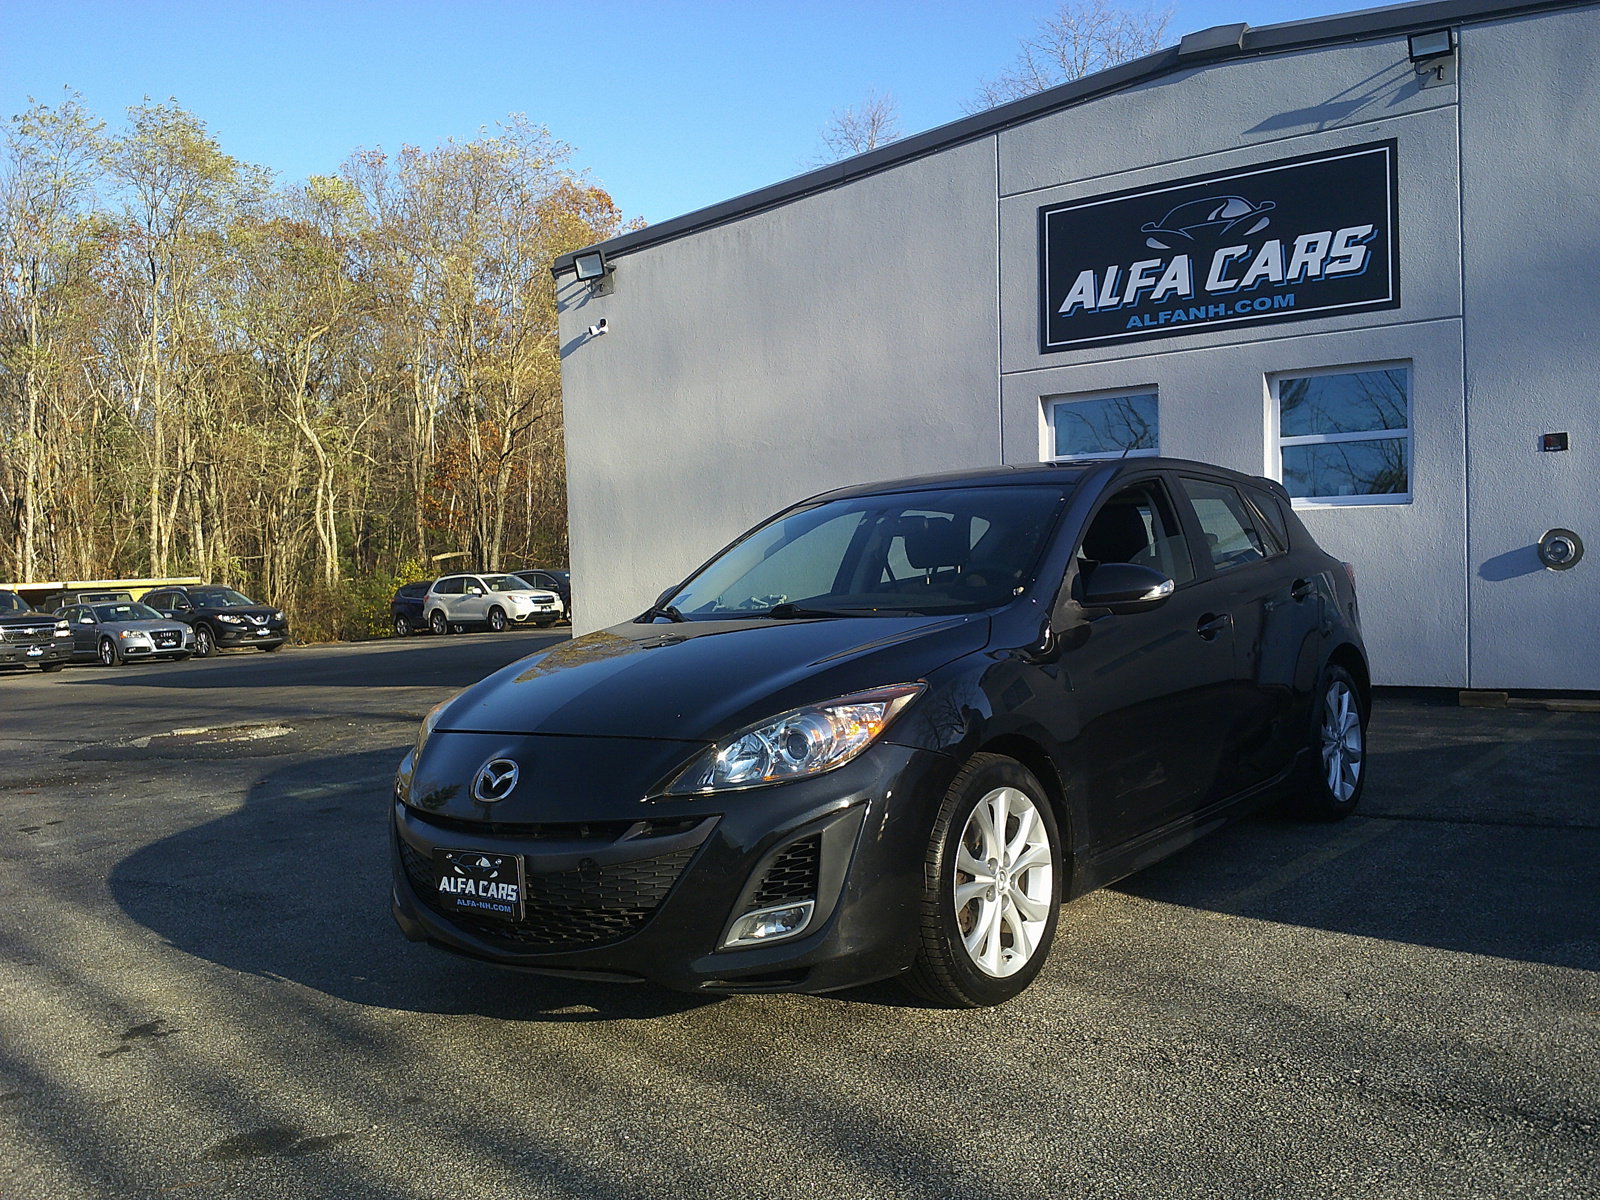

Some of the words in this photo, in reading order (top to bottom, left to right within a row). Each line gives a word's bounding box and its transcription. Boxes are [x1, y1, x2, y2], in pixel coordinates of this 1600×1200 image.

[1058, 254, 1193, 317] ALFA
[1205, 224, 1379, 296] CARS
[1126, 293, 1295, 329] ALFANH.COM
[439, 876, 476, 895] ALFA
[478, 880, 519, 902] CARS
[456, 898, 512, 913] ALFA-NH.COM
